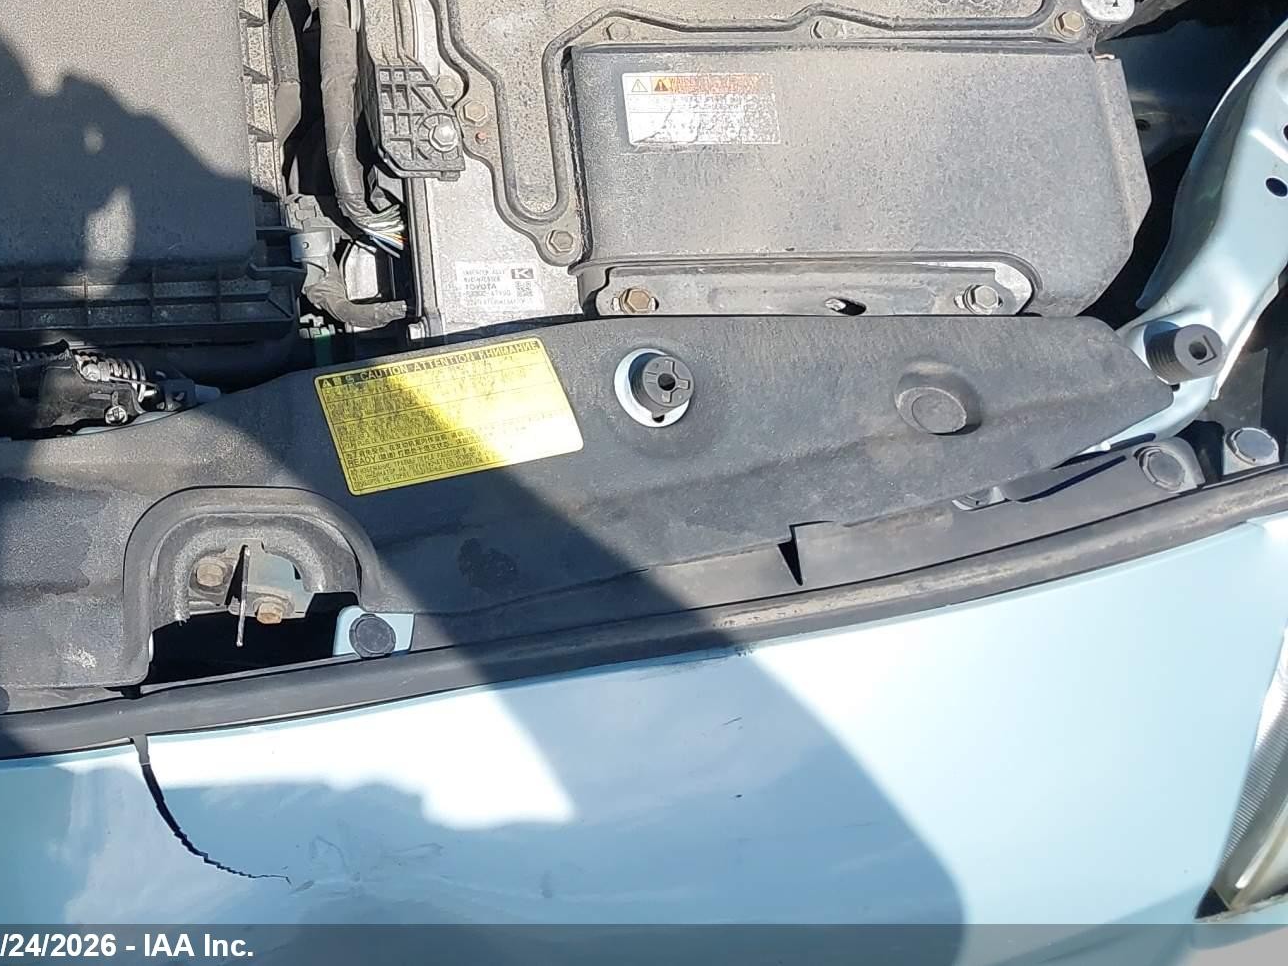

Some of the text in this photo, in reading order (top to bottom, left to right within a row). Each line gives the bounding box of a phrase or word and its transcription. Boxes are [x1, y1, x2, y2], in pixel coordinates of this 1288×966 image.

[360, 364, 409, 381] CAUTION
[414, 353, 475, 372] ATTENTION
[348, 455, 377, 468] READY
